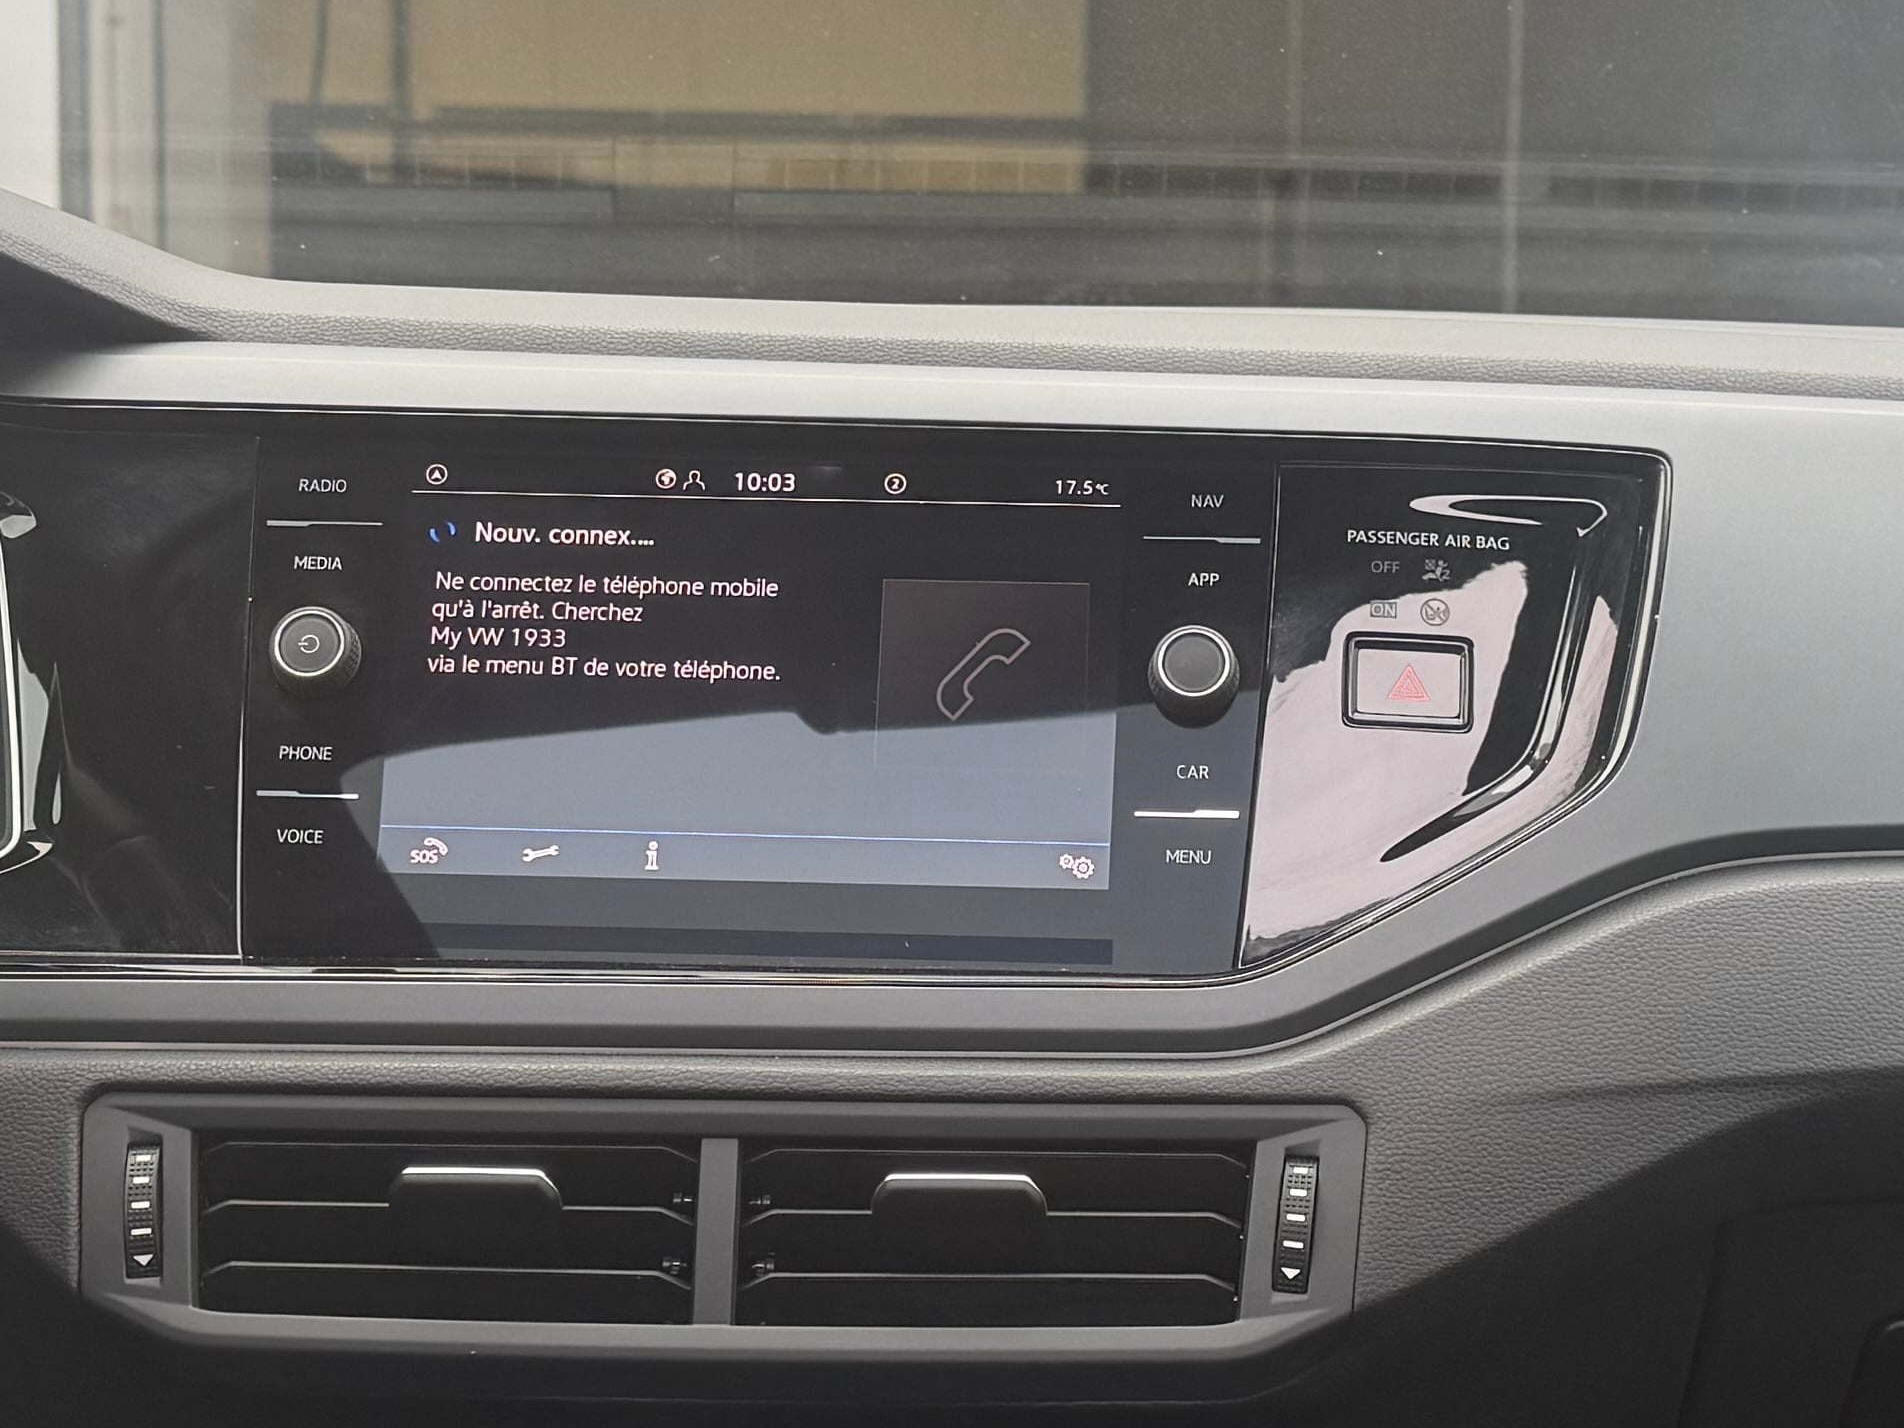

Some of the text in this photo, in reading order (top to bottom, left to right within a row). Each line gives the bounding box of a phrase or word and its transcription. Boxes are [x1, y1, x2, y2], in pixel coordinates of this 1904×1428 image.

[298, 478, 348, 494] RADIO
[734, 472, 796, 493] 10:03
[1191, 494, 1225, 510] NAV
[474, 521, 542, 544] Nouv.
[1347, 529, 1511, 551] PASSENGER AIR BAG
[293, 555, 343, 572] MEDIA
[1371, 560, 1401, 574] OFF
[434, 571, 780, 600] Ne connectez le téléphone mobile
[1188, 572, 1221, 589] APP
[431, 600, 644, 623] qu'à l'arrêt. Cherchez
[1371, 602, 1397, 618] ON
[430, 626, 567, 650] My VW 1933
[427, 655, 782, 684] via le menu BT de votre téléphone.
[279, 745, 333, 762] PHONE
[1175, 765, 1210, 781] CAR
[276, 829, 324, 846] VOICE
[409, 848, 439, 865] SOS
[1165, 848, 1213, 866] MENU
